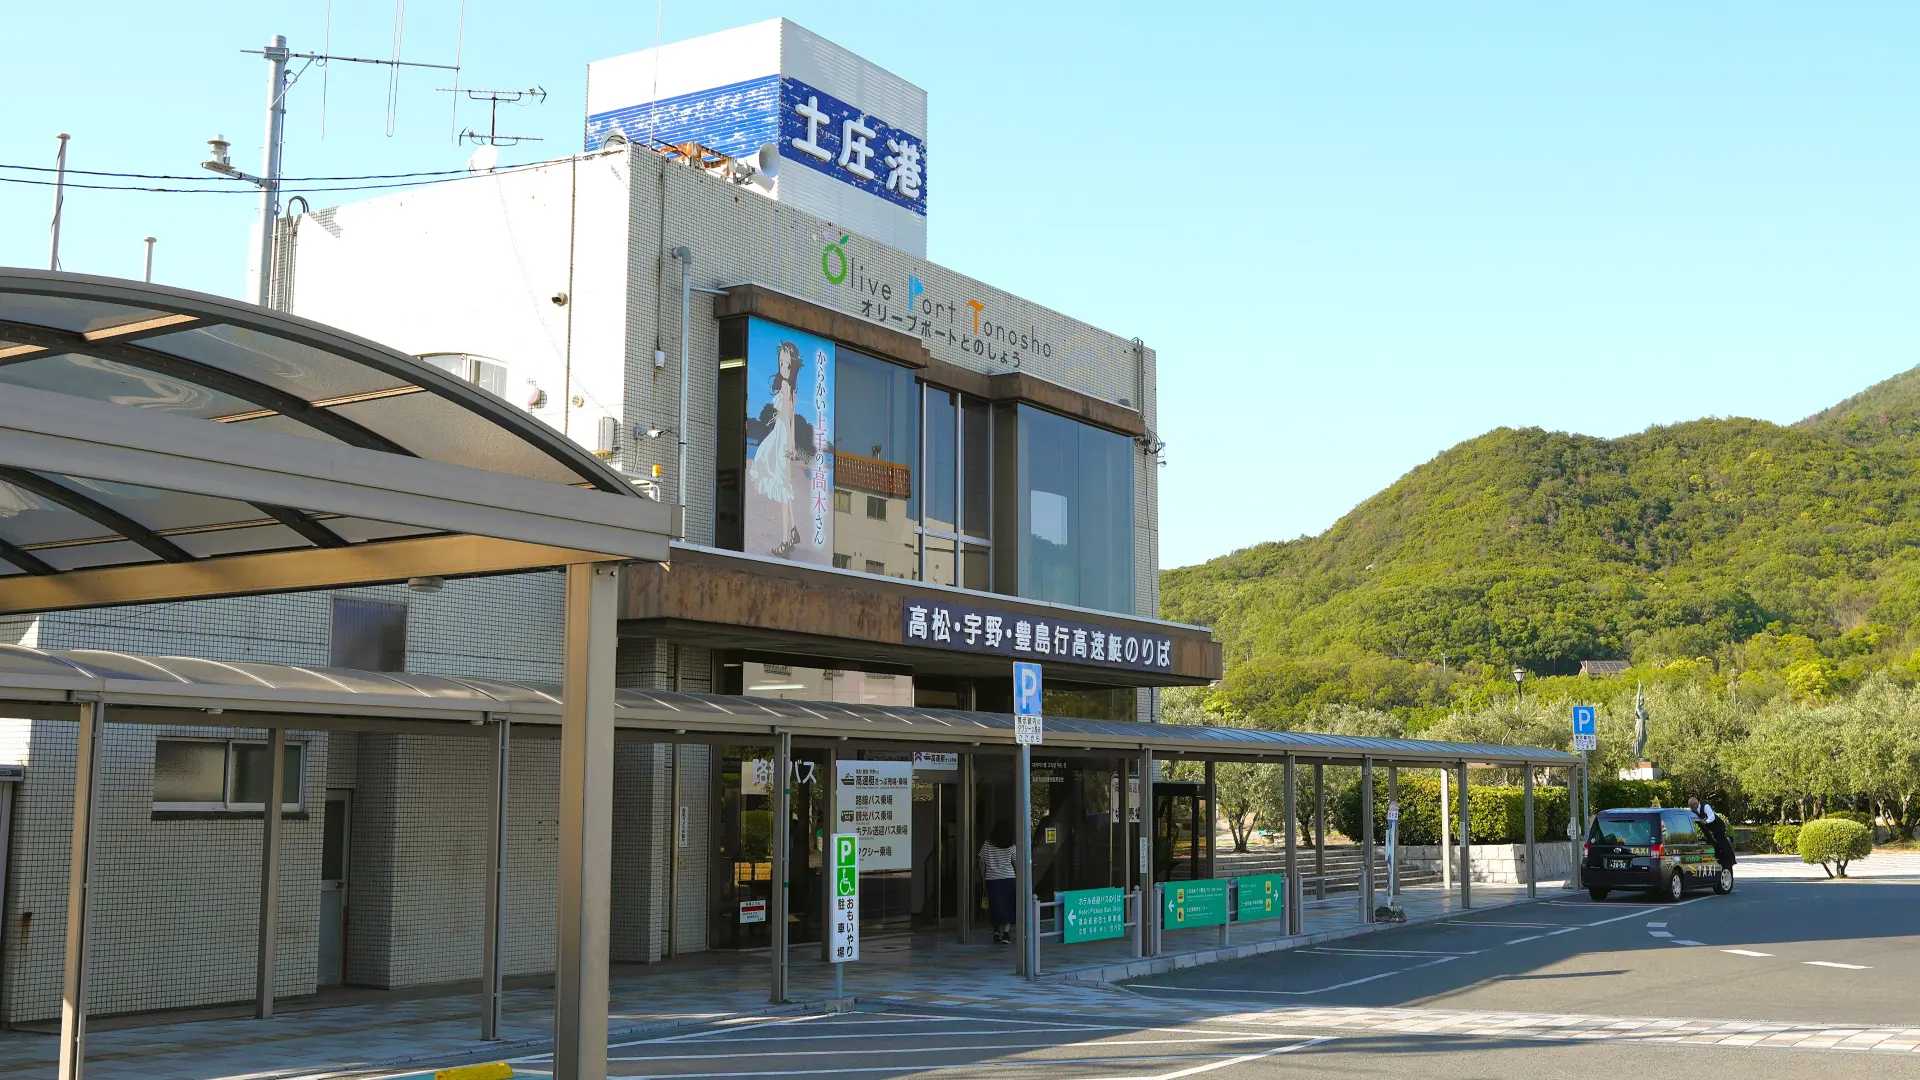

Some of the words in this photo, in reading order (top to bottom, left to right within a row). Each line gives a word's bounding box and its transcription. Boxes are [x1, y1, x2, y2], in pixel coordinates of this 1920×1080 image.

[791, 96, 923, 200] 土庄港
[822, 237, 892, 300] Olive
[908, 274, 956, 323] Port
[967, 299, 1052, 358] Tonosho
[812, 350, 828, 546] からかい上手の高木さん
[907, 604, 1171, 668] 高松・宇野・豊島行高速艇のりば
[1021, 668, 1037, 709] P
[1578, 709, 1591, 731] P
[1018, 734, 1040, 743] ここから
[855, 795, 893, 806] 路線バス乗場
[855, 811, 893, 822] 観光バス乗場
[855, 825, 908, 836] ホテル送迎バス乗場
[841, 840, 852, 863] P
[1630, 847, 1649, 855] TAXI
[1698, 864, 1716, 878] TAXI
[837, 898, 845, 958] 駐車場
[846, 897, 854, 957] おもいやり
